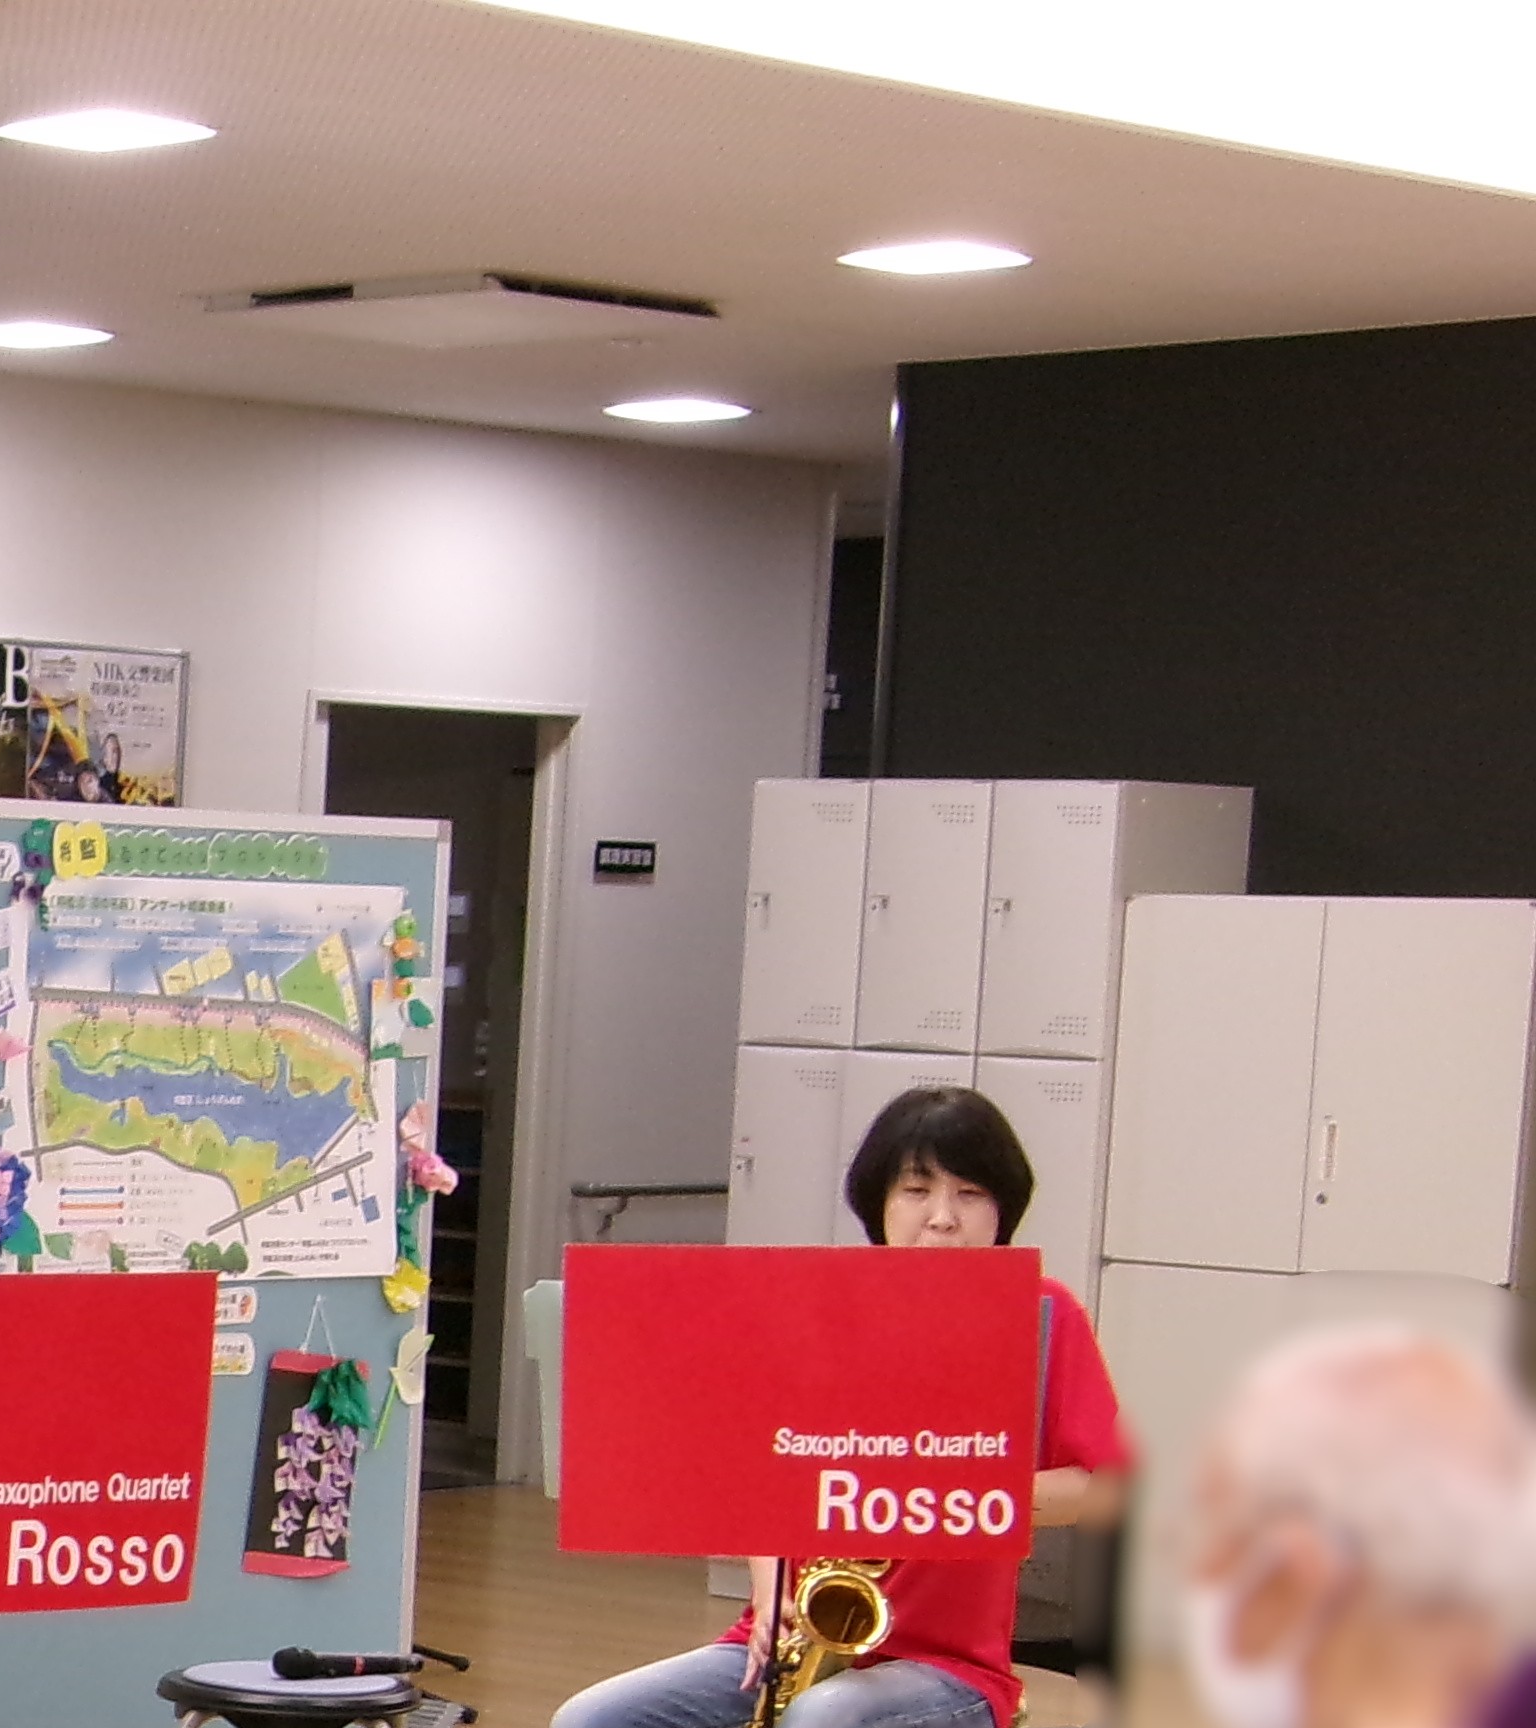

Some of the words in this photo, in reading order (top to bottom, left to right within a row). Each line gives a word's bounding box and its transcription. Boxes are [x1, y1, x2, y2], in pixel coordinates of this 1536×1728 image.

[773, 1426, 908, 1461] Saxophone
[913, 1428, 1008, 1457] Quartet
[107, 1472, 191, 1501] Quartet
